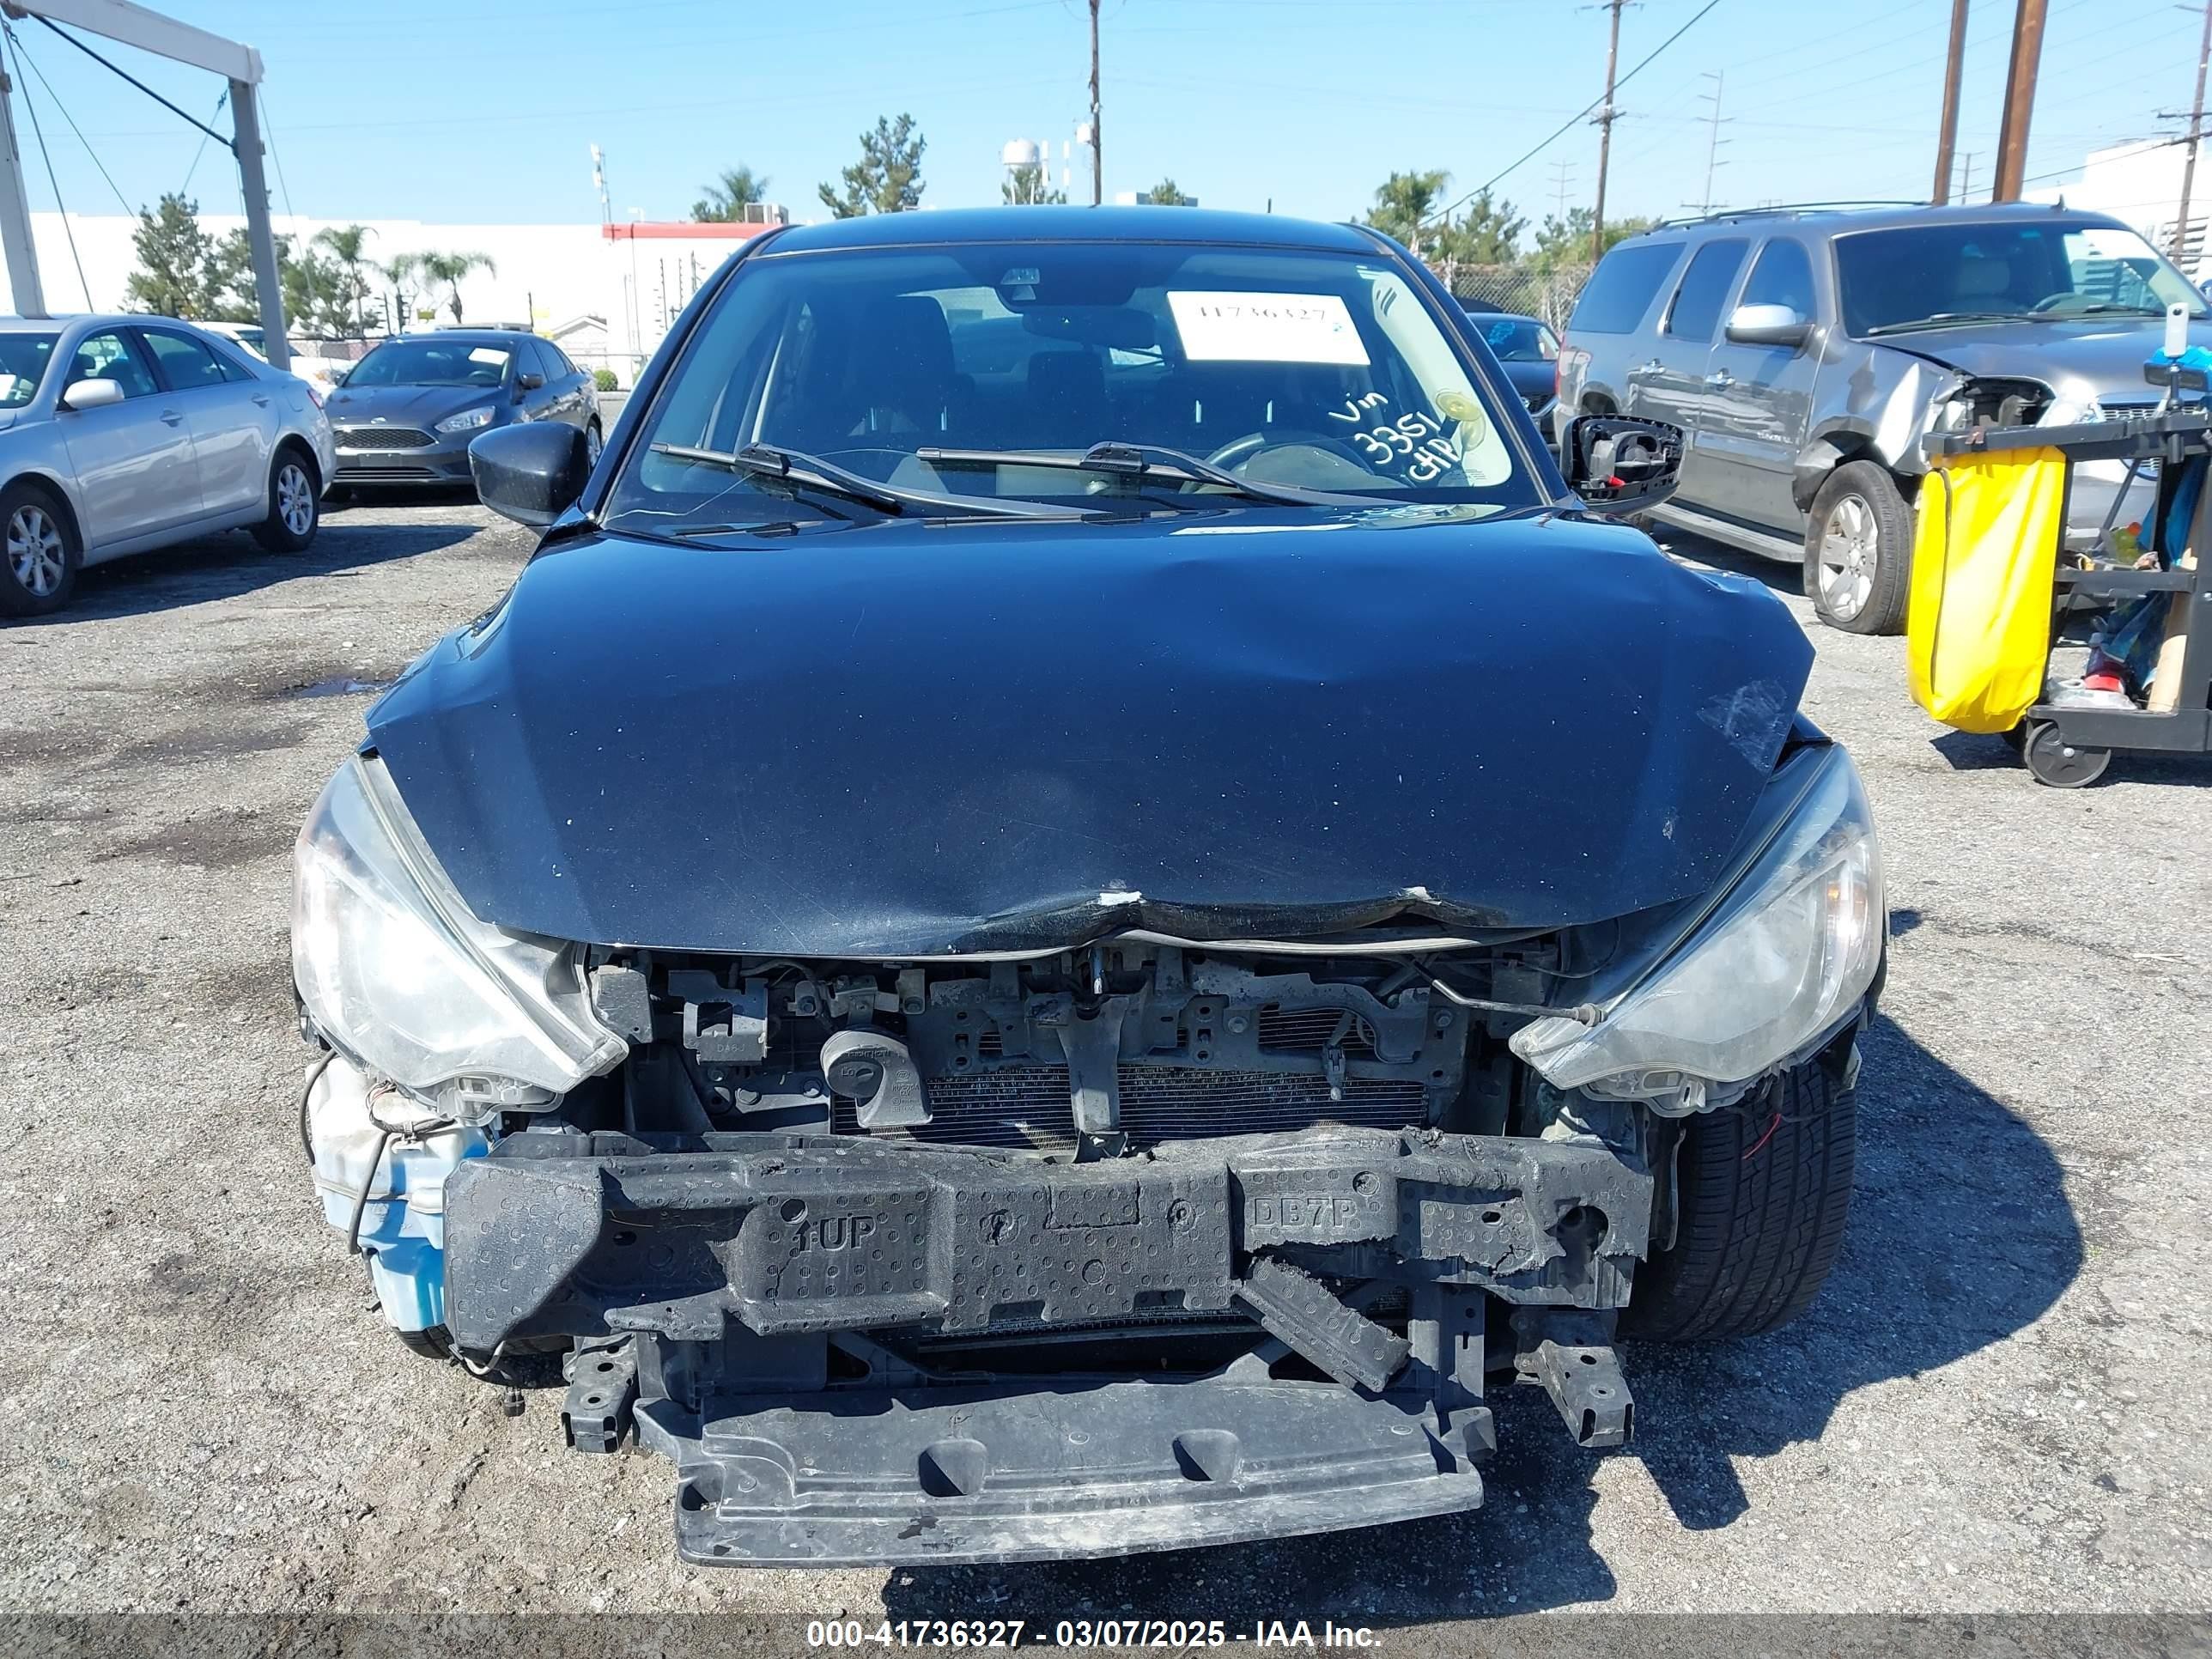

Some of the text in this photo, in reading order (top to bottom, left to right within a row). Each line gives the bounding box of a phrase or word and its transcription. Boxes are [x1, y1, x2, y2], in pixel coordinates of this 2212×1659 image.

[1353, 410, 1442, 465] 3351
[1254, 1196, 1357, 1228] DB7P
[818, 1214, 877, 1251] UP
